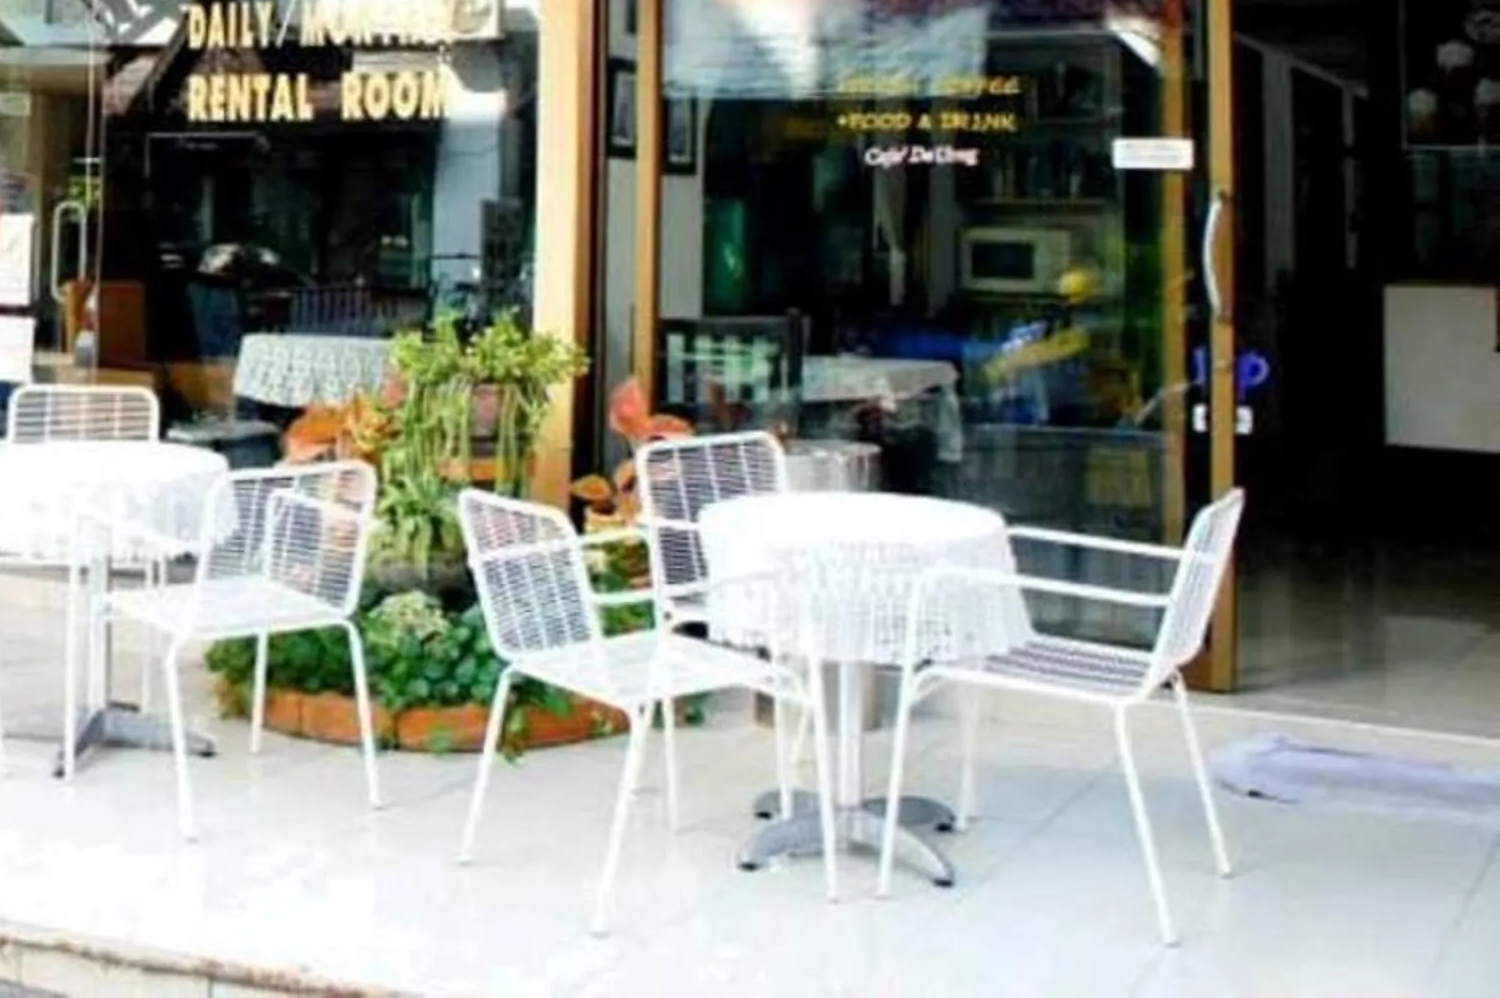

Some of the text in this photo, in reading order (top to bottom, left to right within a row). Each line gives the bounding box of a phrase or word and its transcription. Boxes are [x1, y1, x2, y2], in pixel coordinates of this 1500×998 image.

[188, 72, 448, 121] RENTAL ROOM
[940, 112, 1018, 132] DRINK
